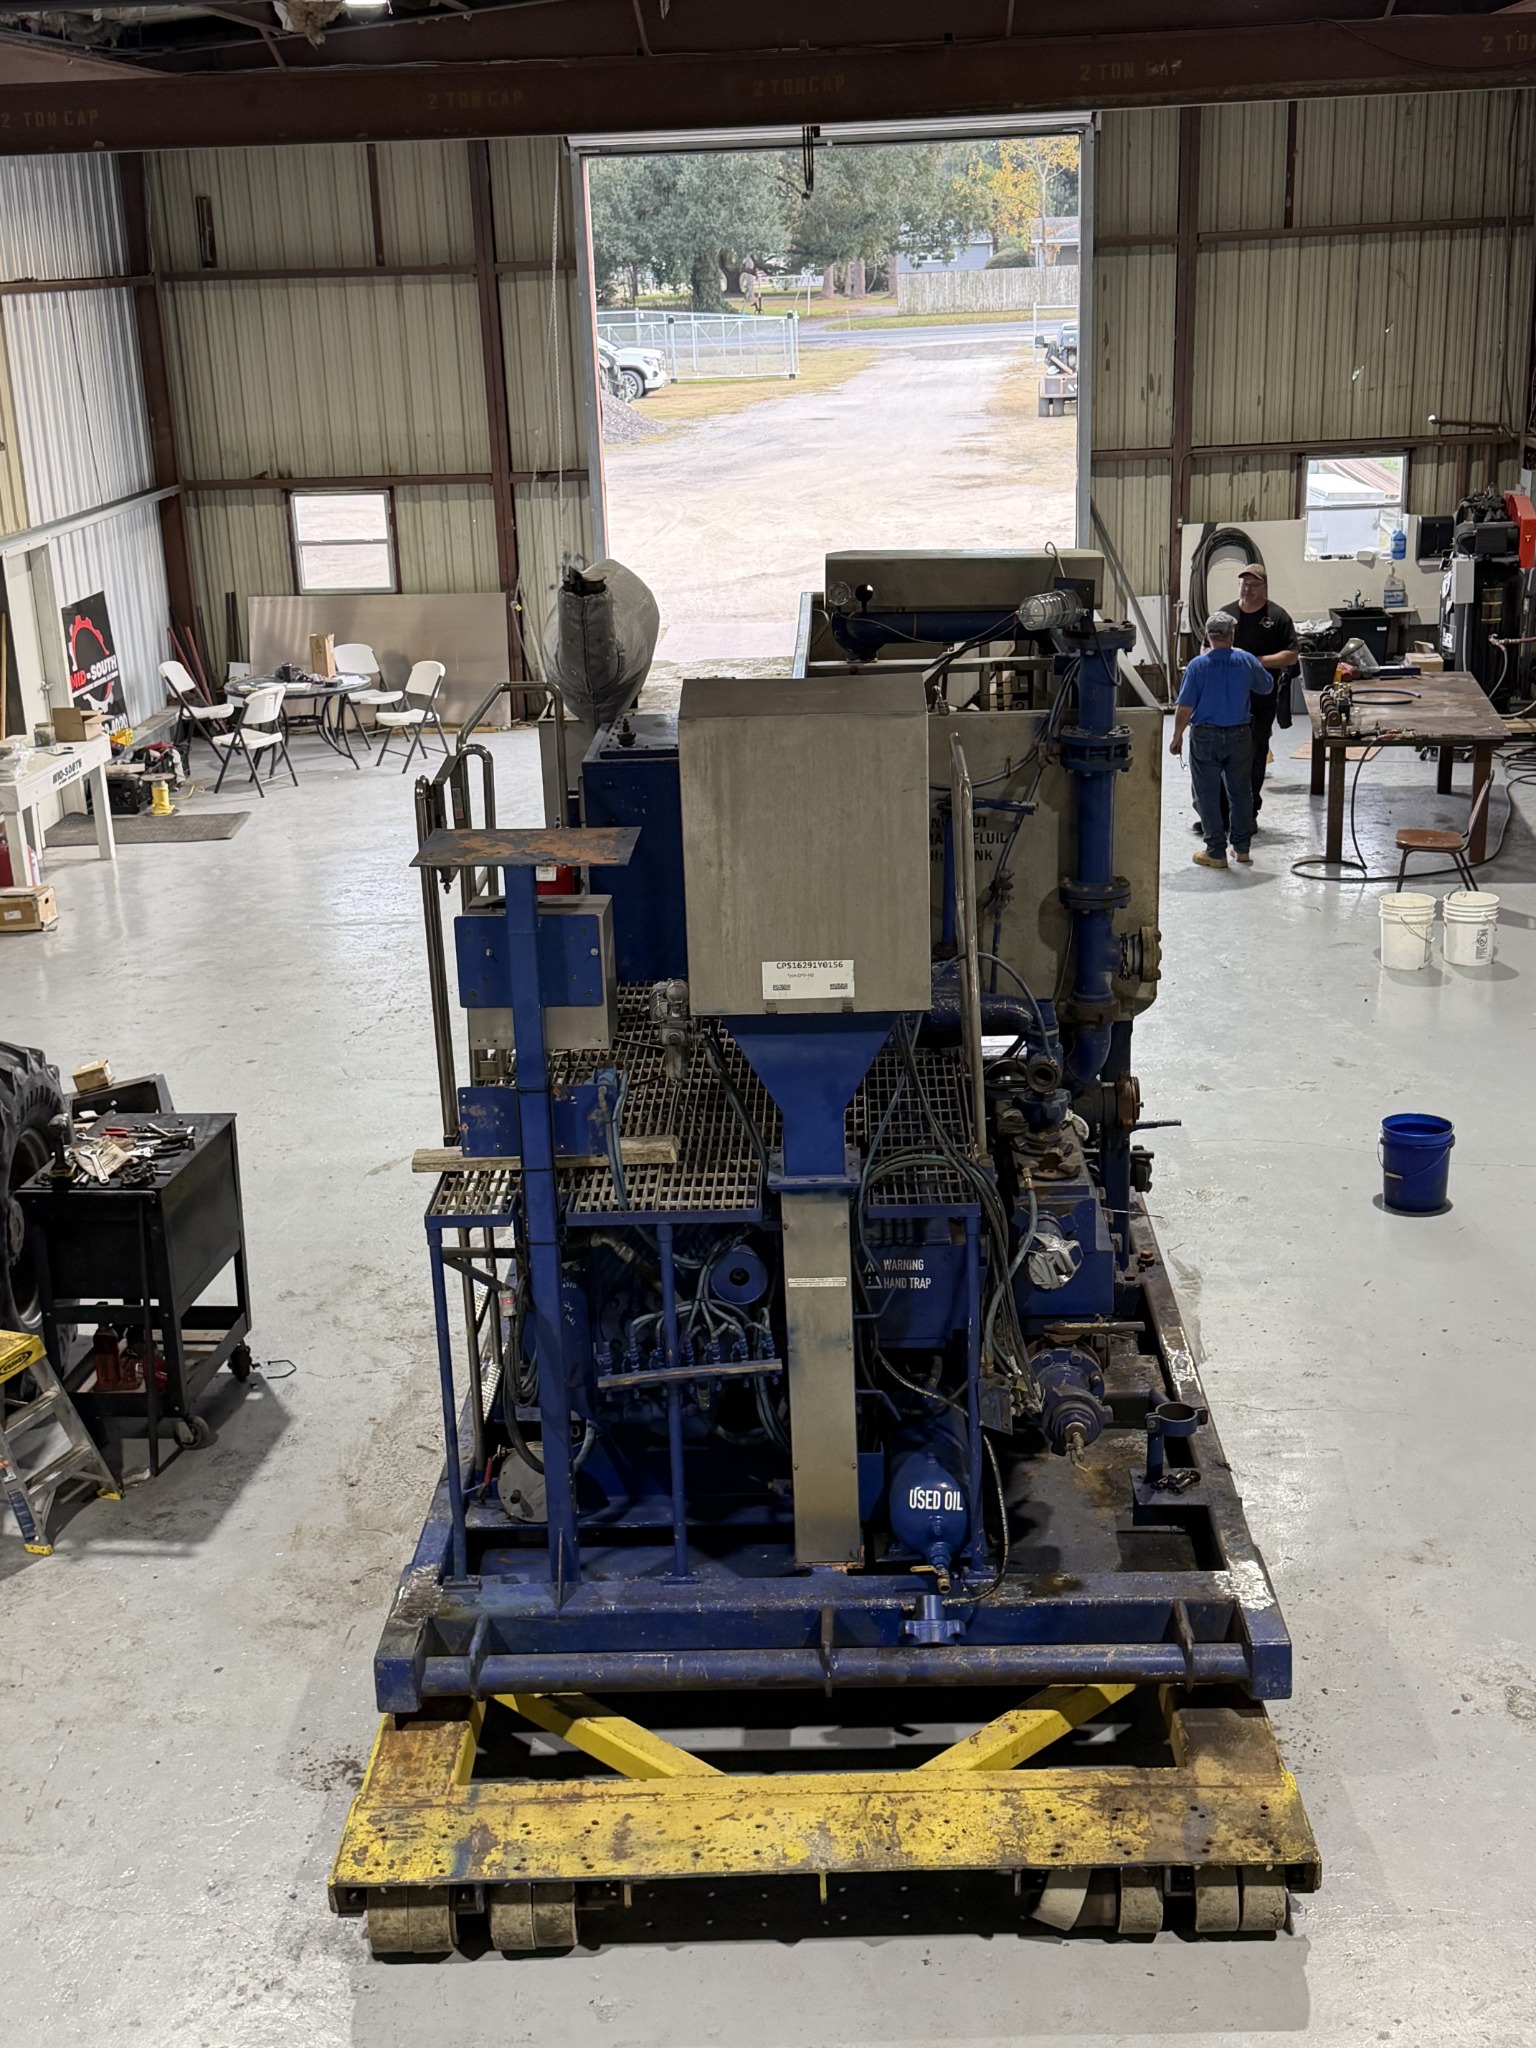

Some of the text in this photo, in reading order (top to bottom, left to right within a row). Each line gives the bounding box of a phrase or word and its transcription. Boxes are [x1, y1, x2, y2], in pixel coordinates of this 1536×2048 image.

[1481, 36, 1493, 52] 2
[1079, 63, 1090, 81] 2
[1098, 61, 1135, 81] TON
[753, 79, 765, 97] 2
[808, 74, 845, 93] CAP
[426, 92, 438, 110] 2
[0, 108, 99, 128] 2 TON CAP
[69, 655, 118, 689] MID-SOUTH
[883, 1259, 925, 1271] WARNING
[883, 1277, 932, 1289] HAND TRAP
[909, 1489, 964, 1511] USED OIL
